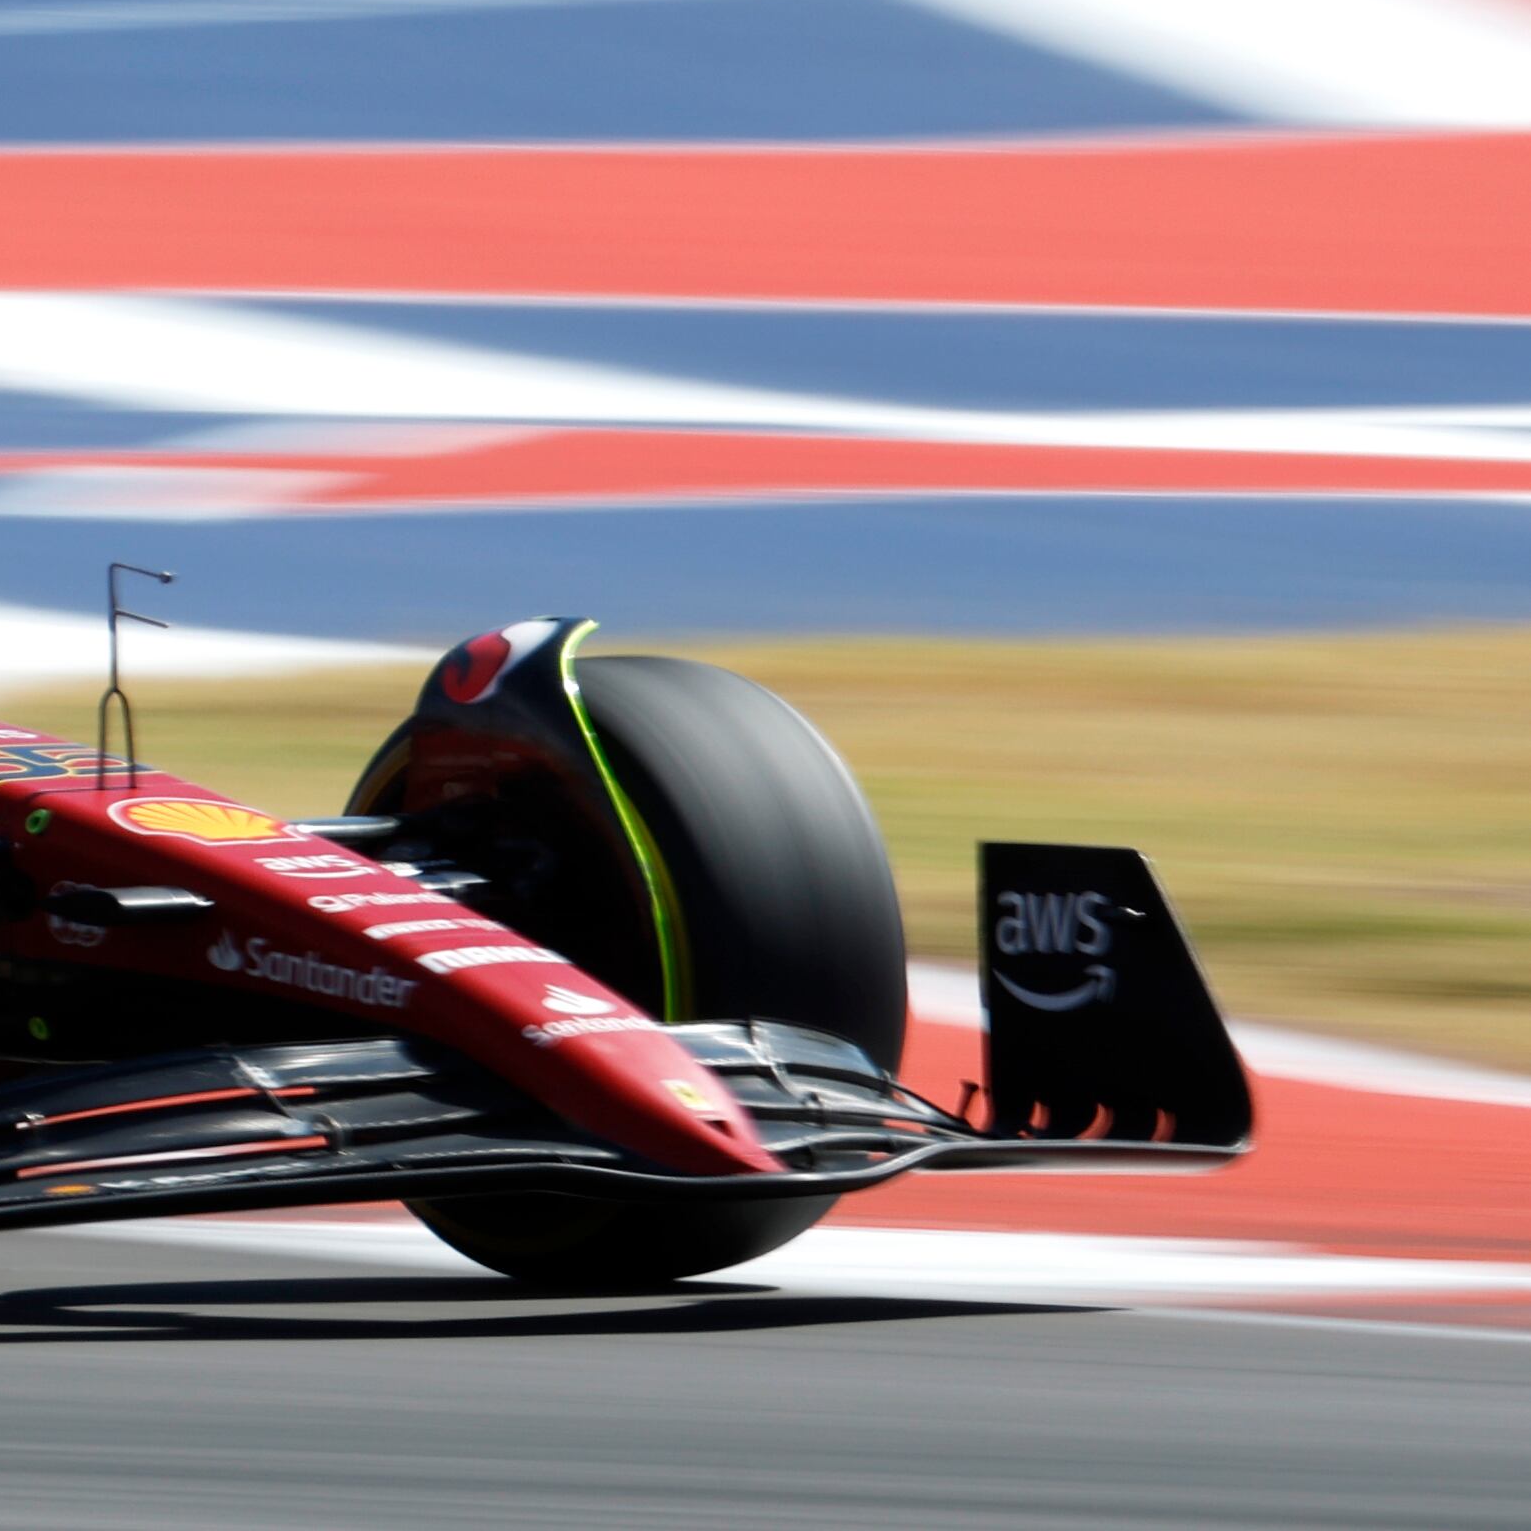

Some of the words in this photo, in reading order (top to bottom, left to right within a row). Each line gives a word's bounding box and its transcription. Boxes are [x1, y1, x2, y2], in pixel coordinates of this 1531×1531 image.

[252, 854, 361, 871] aws
[994, 889, 1114, 958] aws
[244, 936, 421, 1009] Santander
